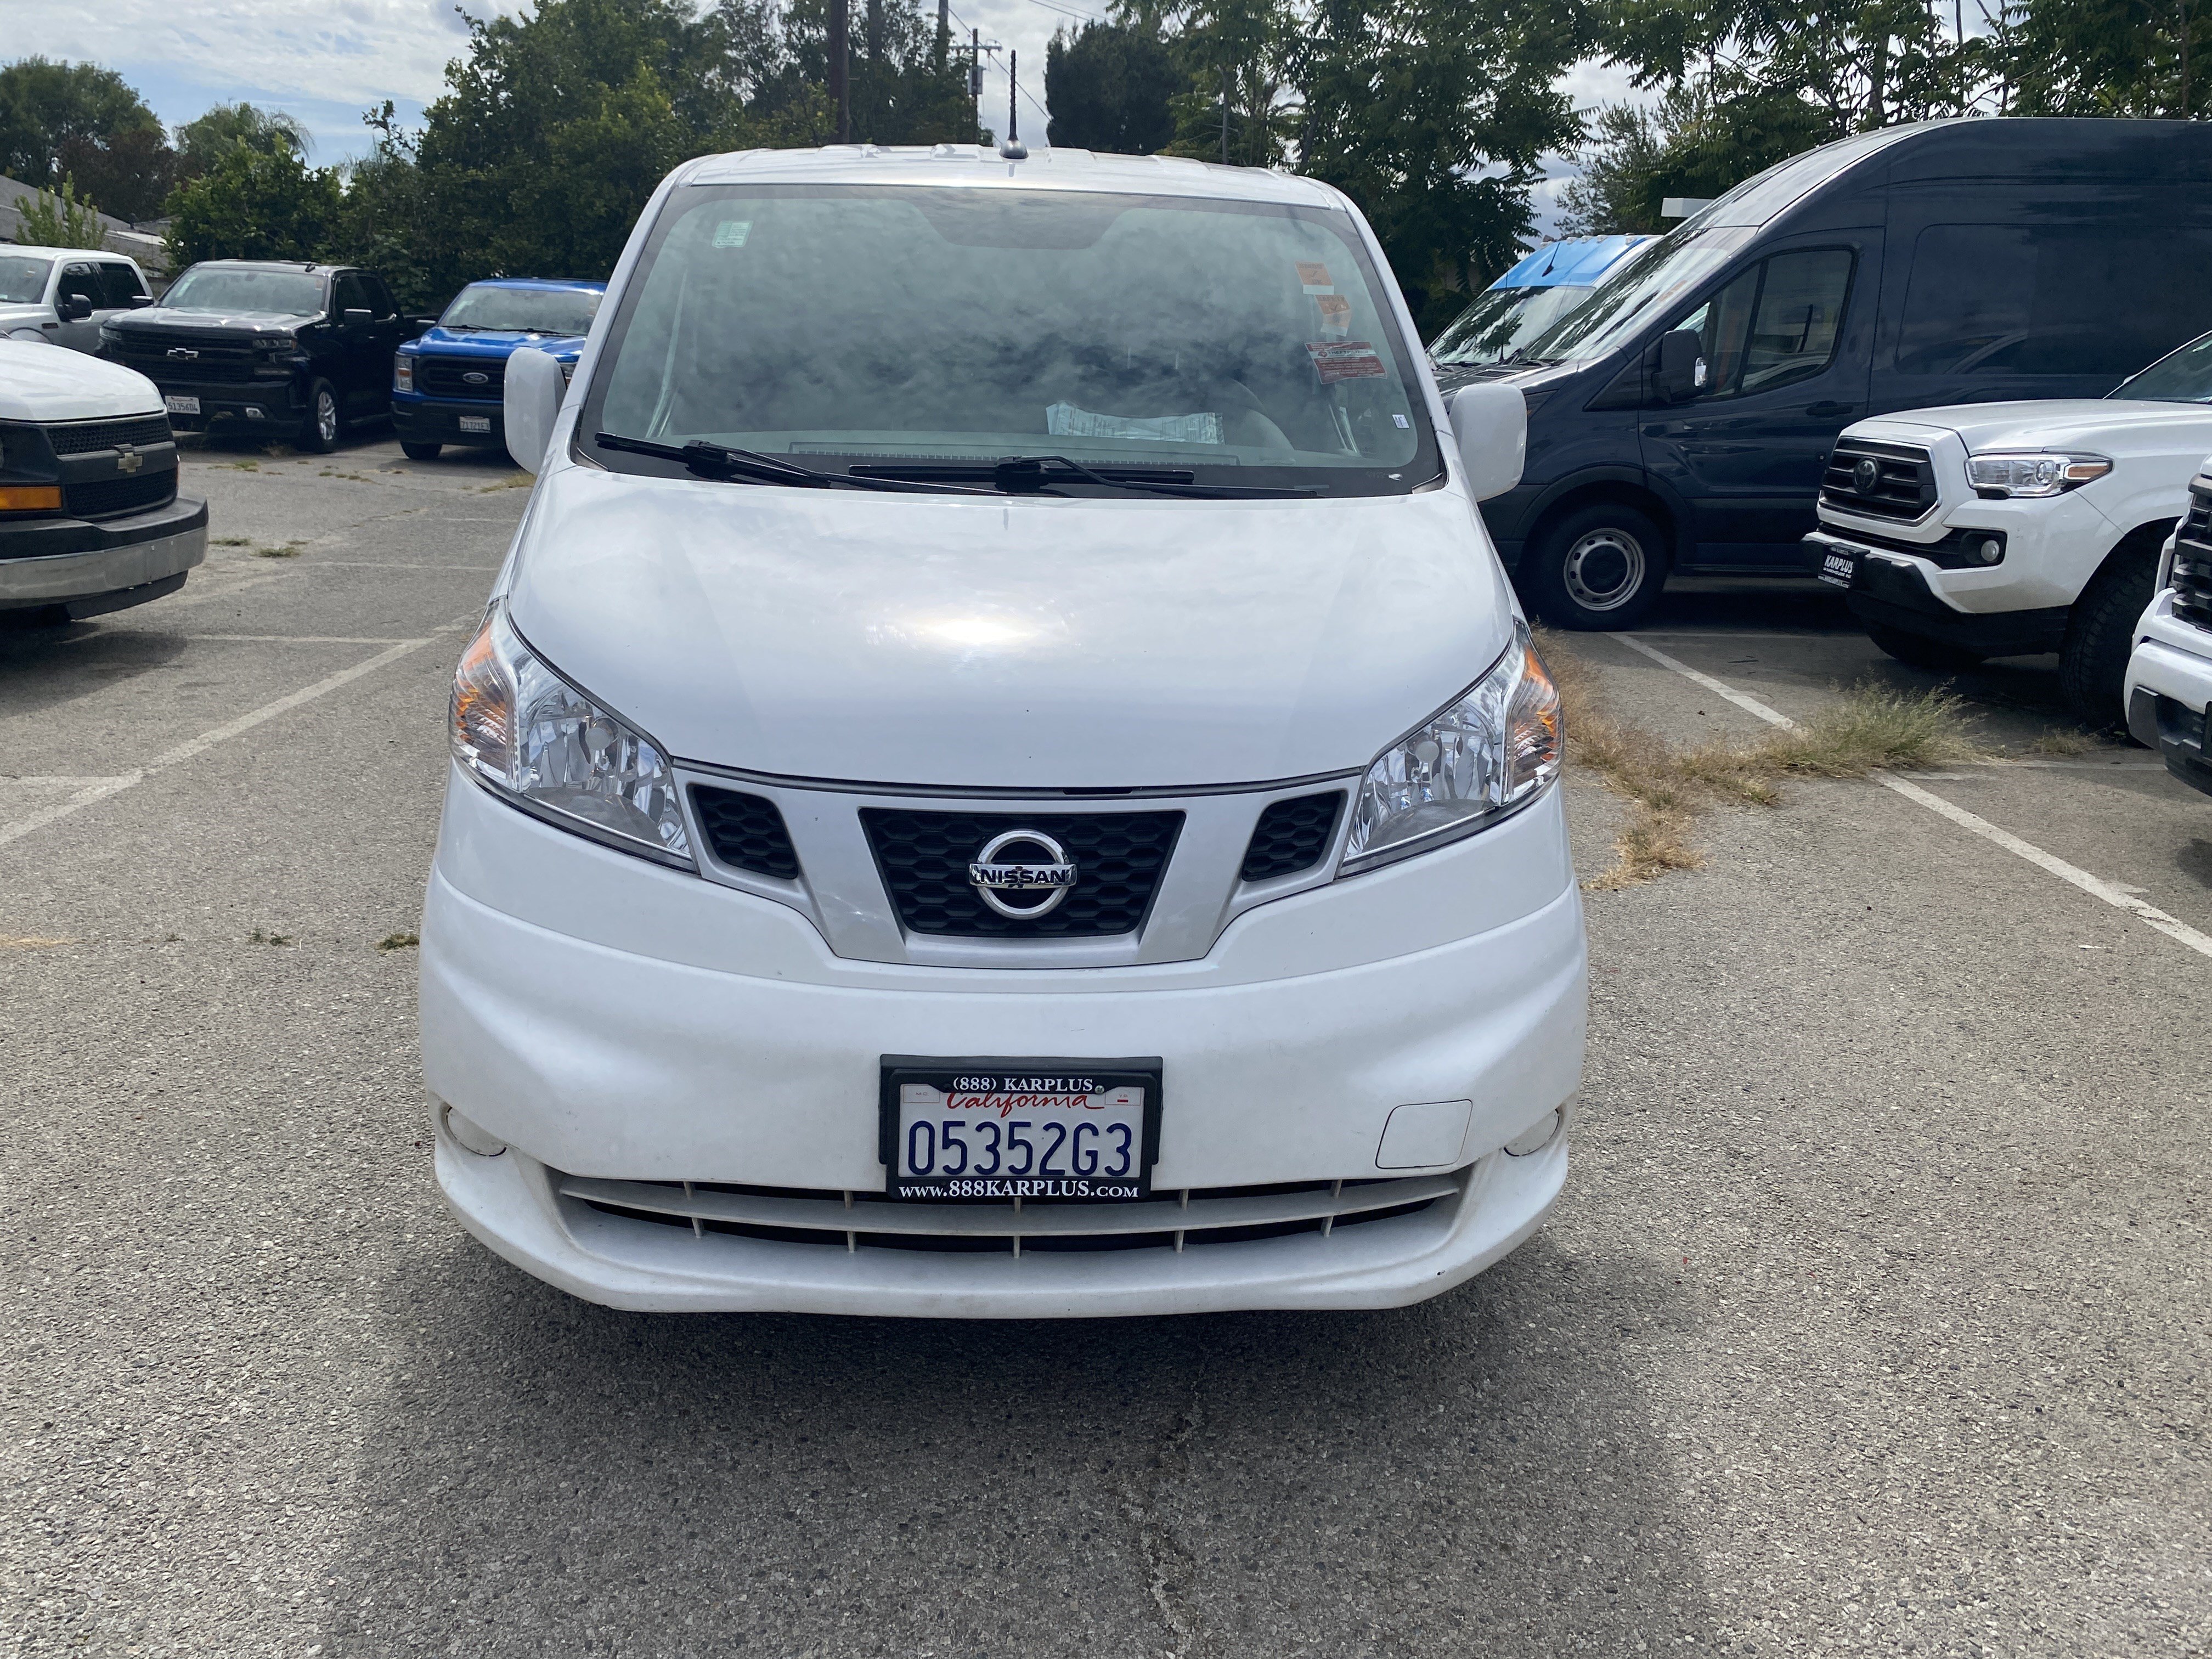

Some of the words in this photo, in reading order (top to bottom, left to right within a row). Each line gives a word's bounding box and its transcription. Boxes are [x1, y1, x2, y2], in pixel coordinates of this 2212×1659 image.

[1824, 555, 1854, 574] KARPLUS
[980, 869, 1066, 884] NISSAN
[953, 1077, 997, 1091] (888)
[1003, 1077, 1093, 1092] KARPLUS
[947, 1092, 1105, 1118] California
[908, 1120, 1132, 1176] 05352G3
